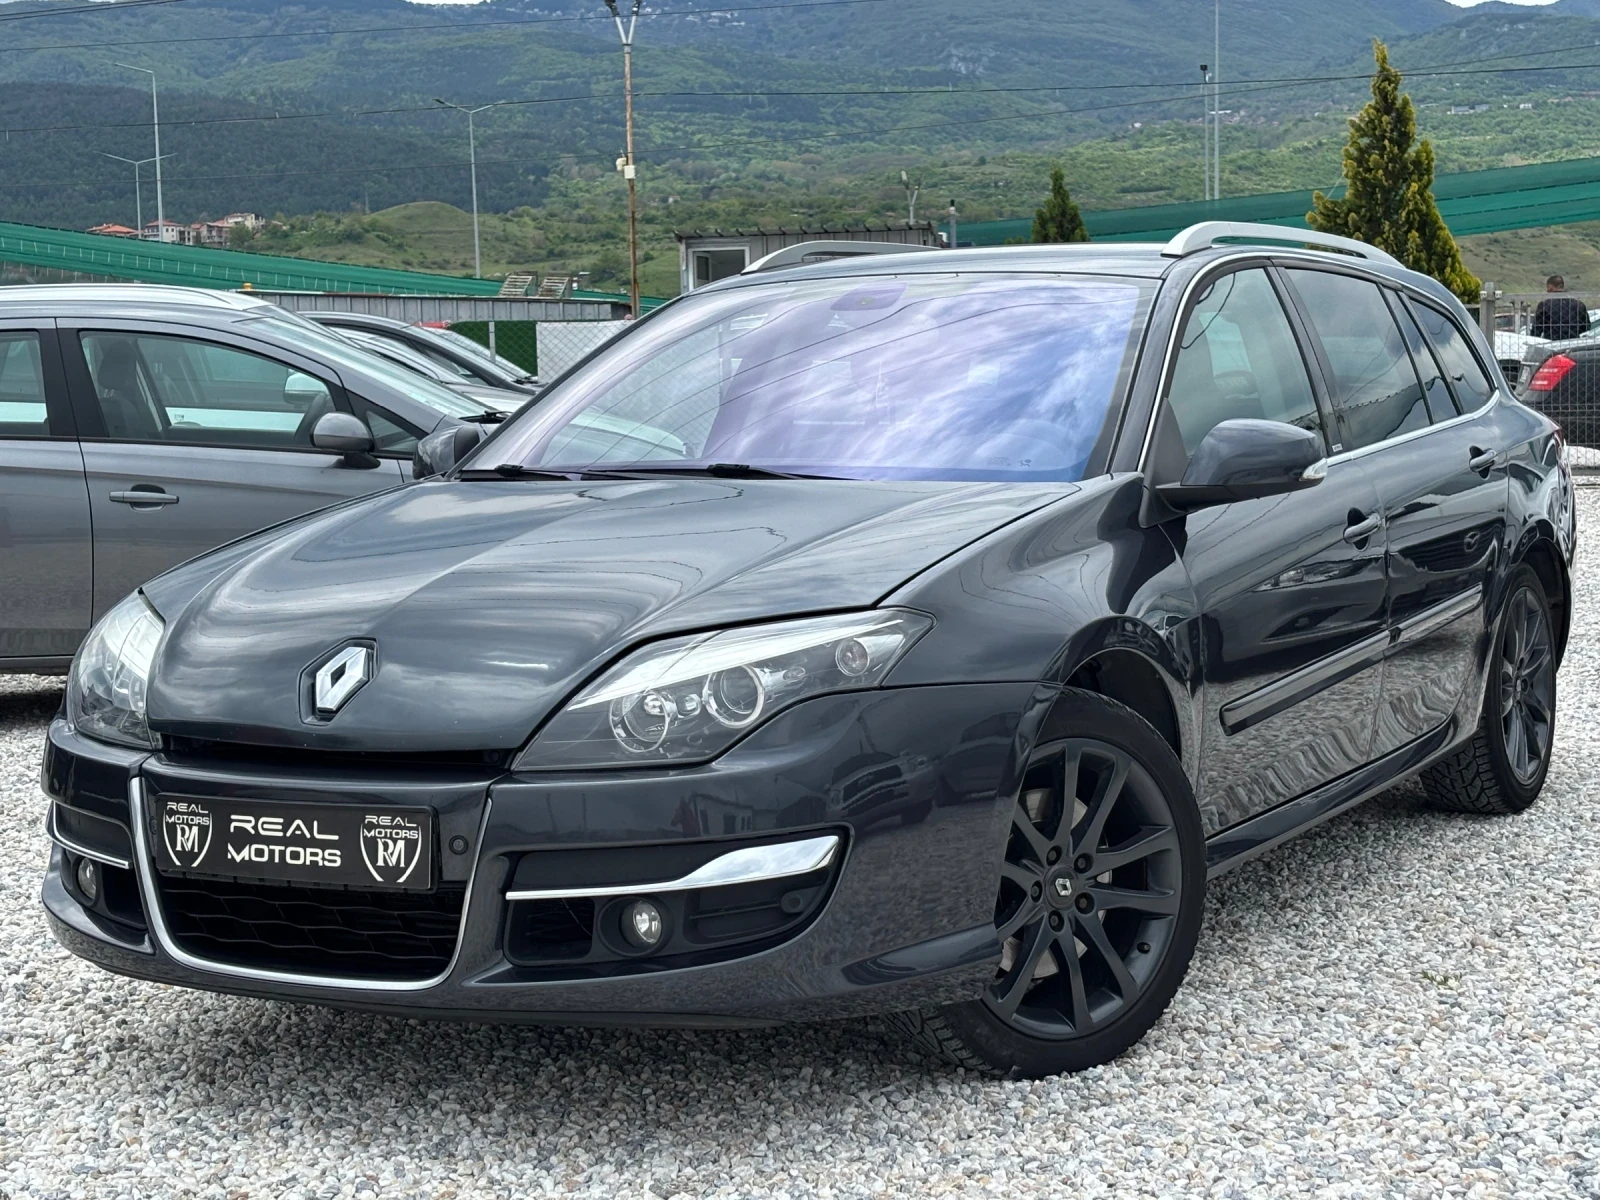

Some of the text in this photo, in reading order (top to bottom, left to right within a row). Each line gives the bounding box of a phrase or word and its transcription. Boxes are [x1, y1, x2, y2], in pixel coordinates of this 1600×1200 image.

[166, 801, 209, 814] REAL
[165, 815, 210, 826] MOTORS
[364, 815, 418, 827] REAL
[229, 814, 340, 840] REAL
[363, 828, 419, 839] MOTORS
[227, 842, 342, 867] MOTORS
